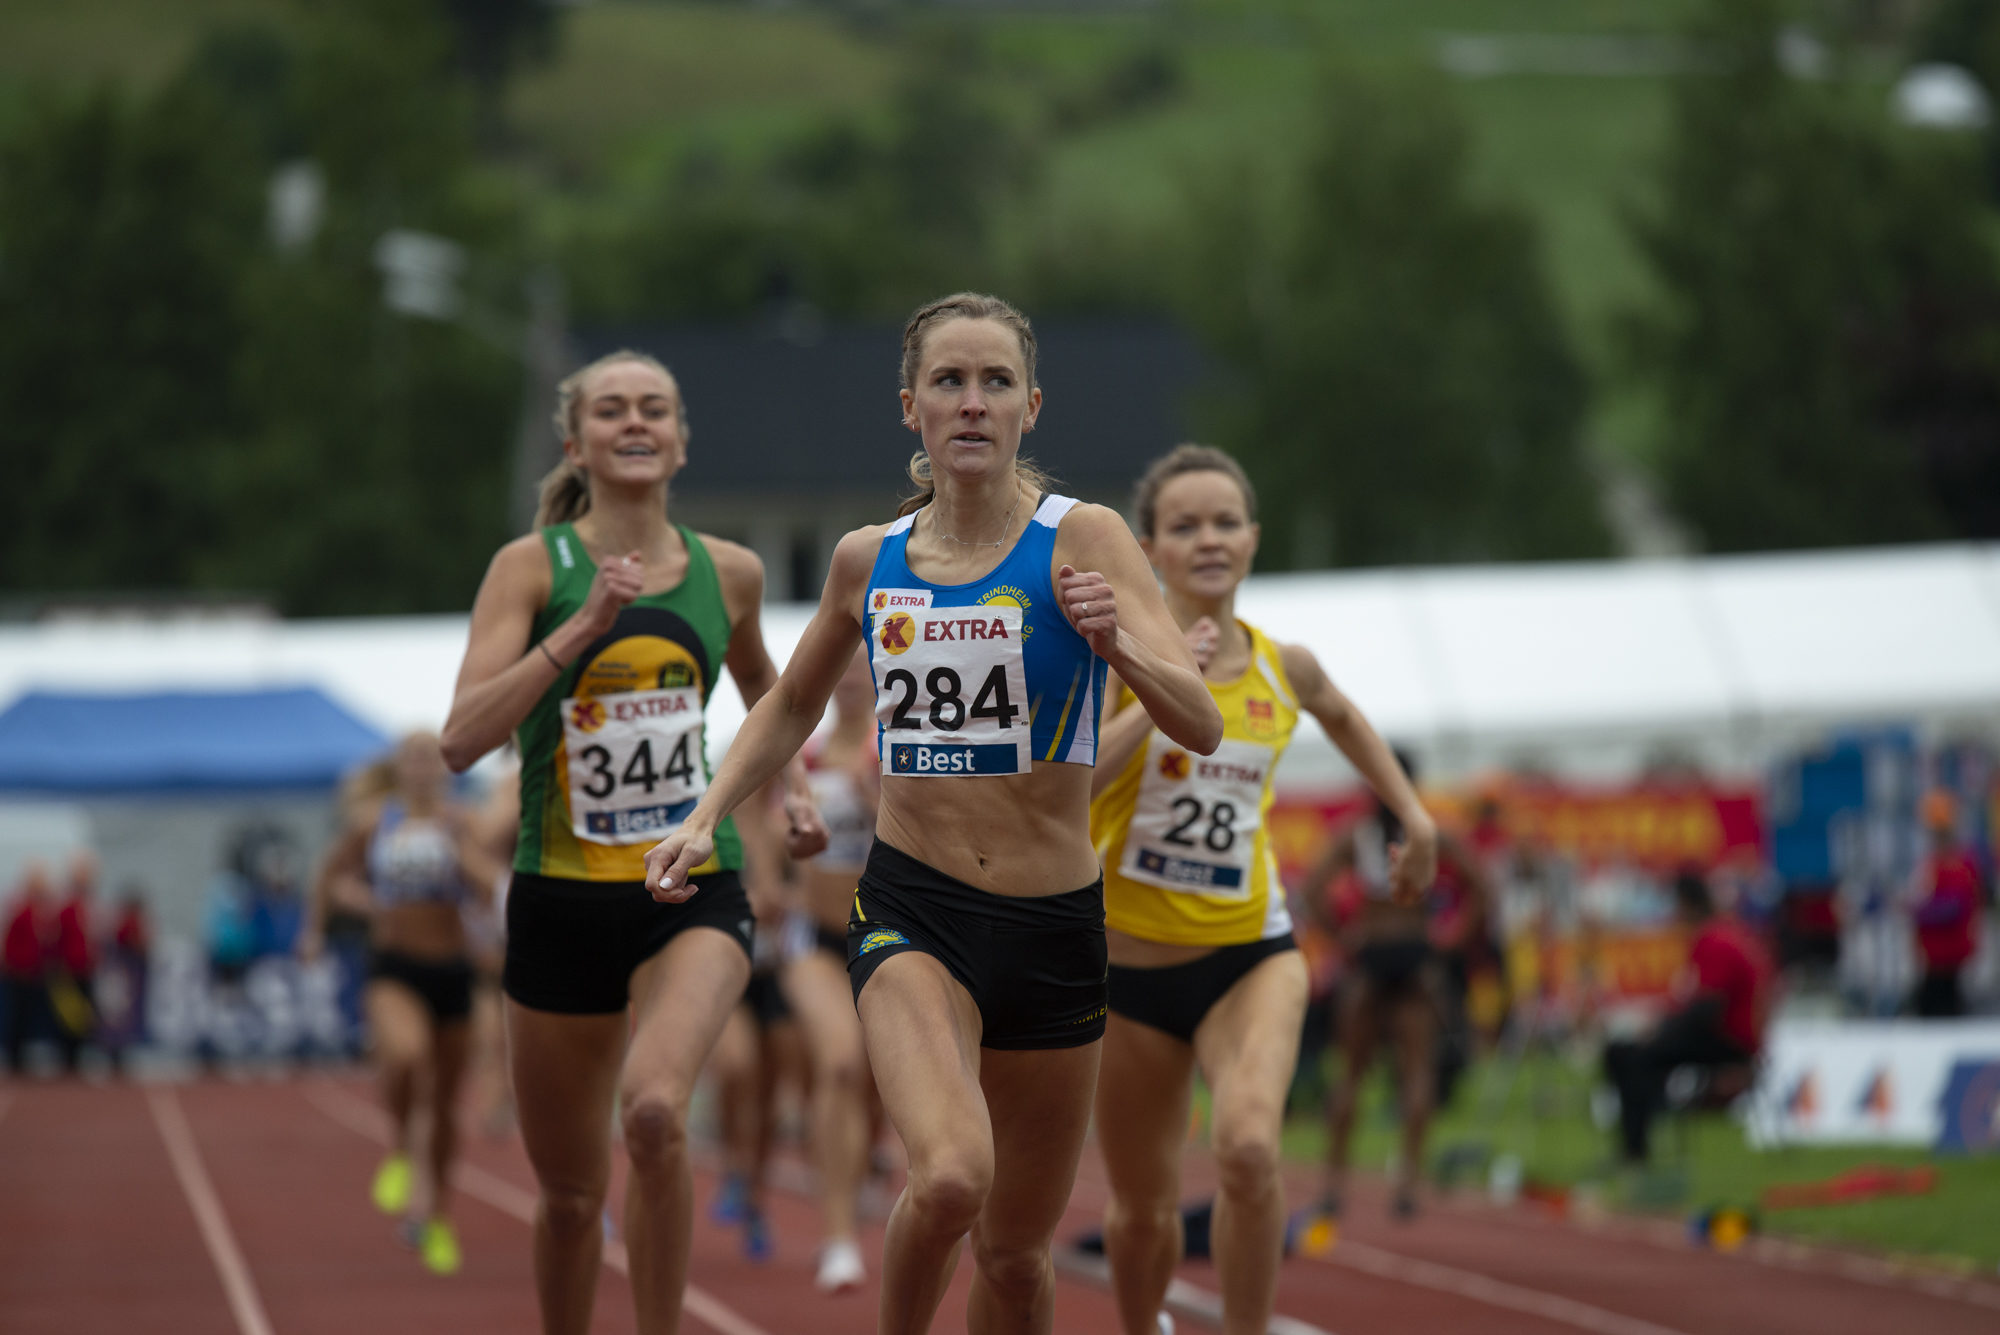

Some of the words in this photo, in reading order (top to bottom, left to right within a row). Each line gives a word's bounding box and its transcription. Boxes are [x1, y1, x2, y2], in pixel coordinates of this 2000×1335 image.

[890, 596, 925, 607] EXTRA
[975, 585, 1032, 609] TRINDHEIM
[924, 619, 1009, 642] EXTRA
[615, 694, 688, 721] EXTRA
[884, 665, 1019, 731] 284
[581, 733, 695, 800] 344
[916, 747, 976, 772] Best
[1196, 763, 1264, 783] EXTRA
[614, 807, 669, 834] Best
[1164, 797, 1237, 853] 28
